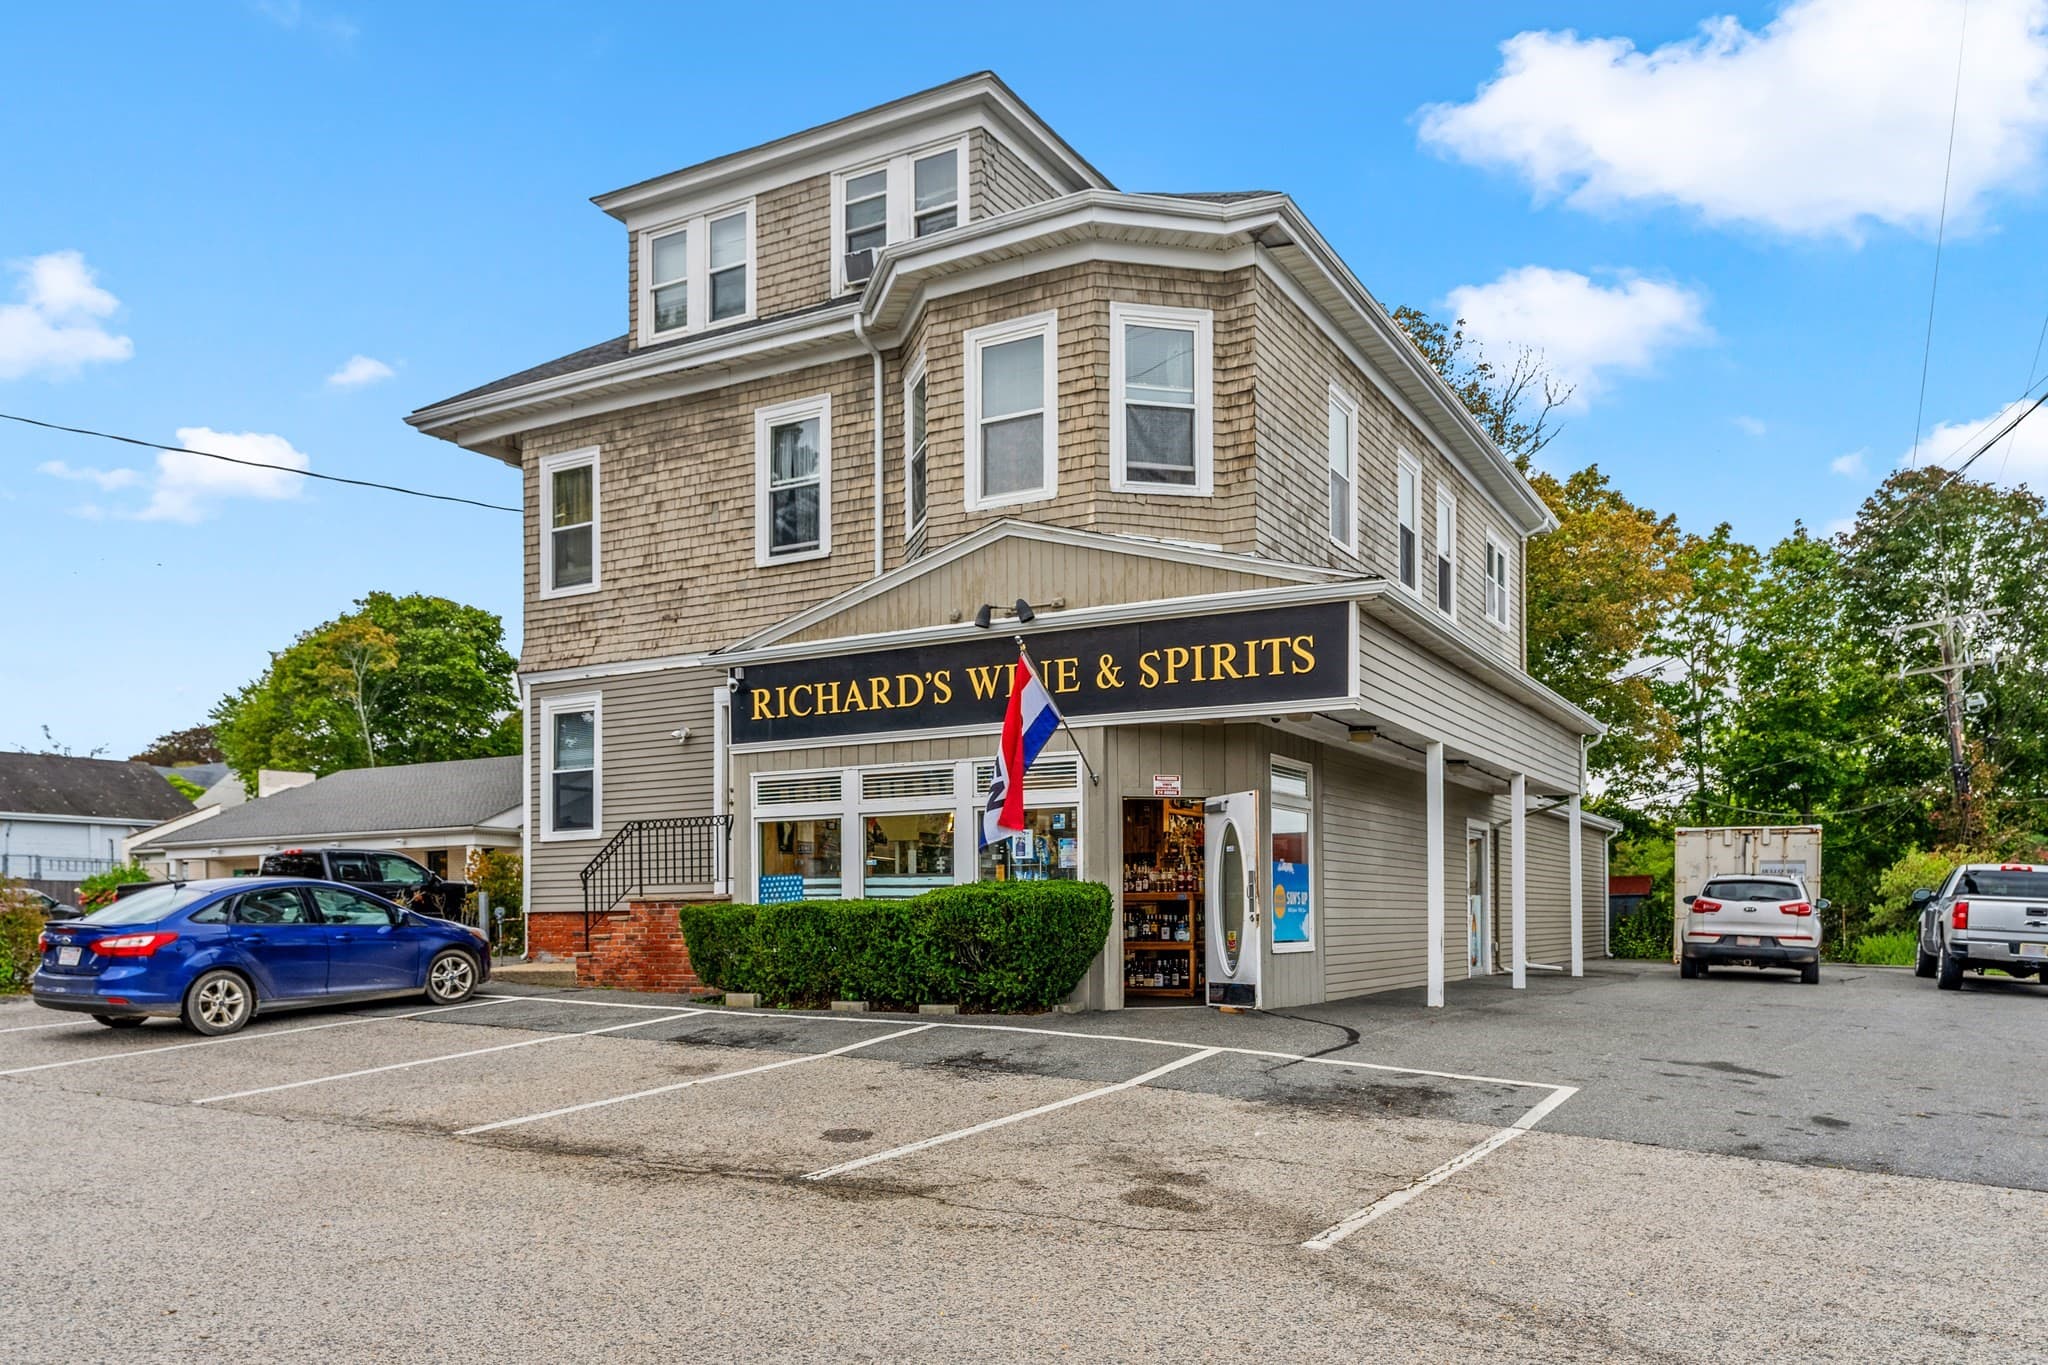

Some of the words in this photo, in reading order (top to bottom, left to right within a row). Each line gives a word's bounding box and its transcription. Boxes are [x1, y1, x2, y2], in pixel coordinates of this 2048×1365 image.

[752, 669, 953, 720] RICHARD'S
[1096, 653, 1125, 689] &
[1139, 635, 1316, 688] SPIRITS
